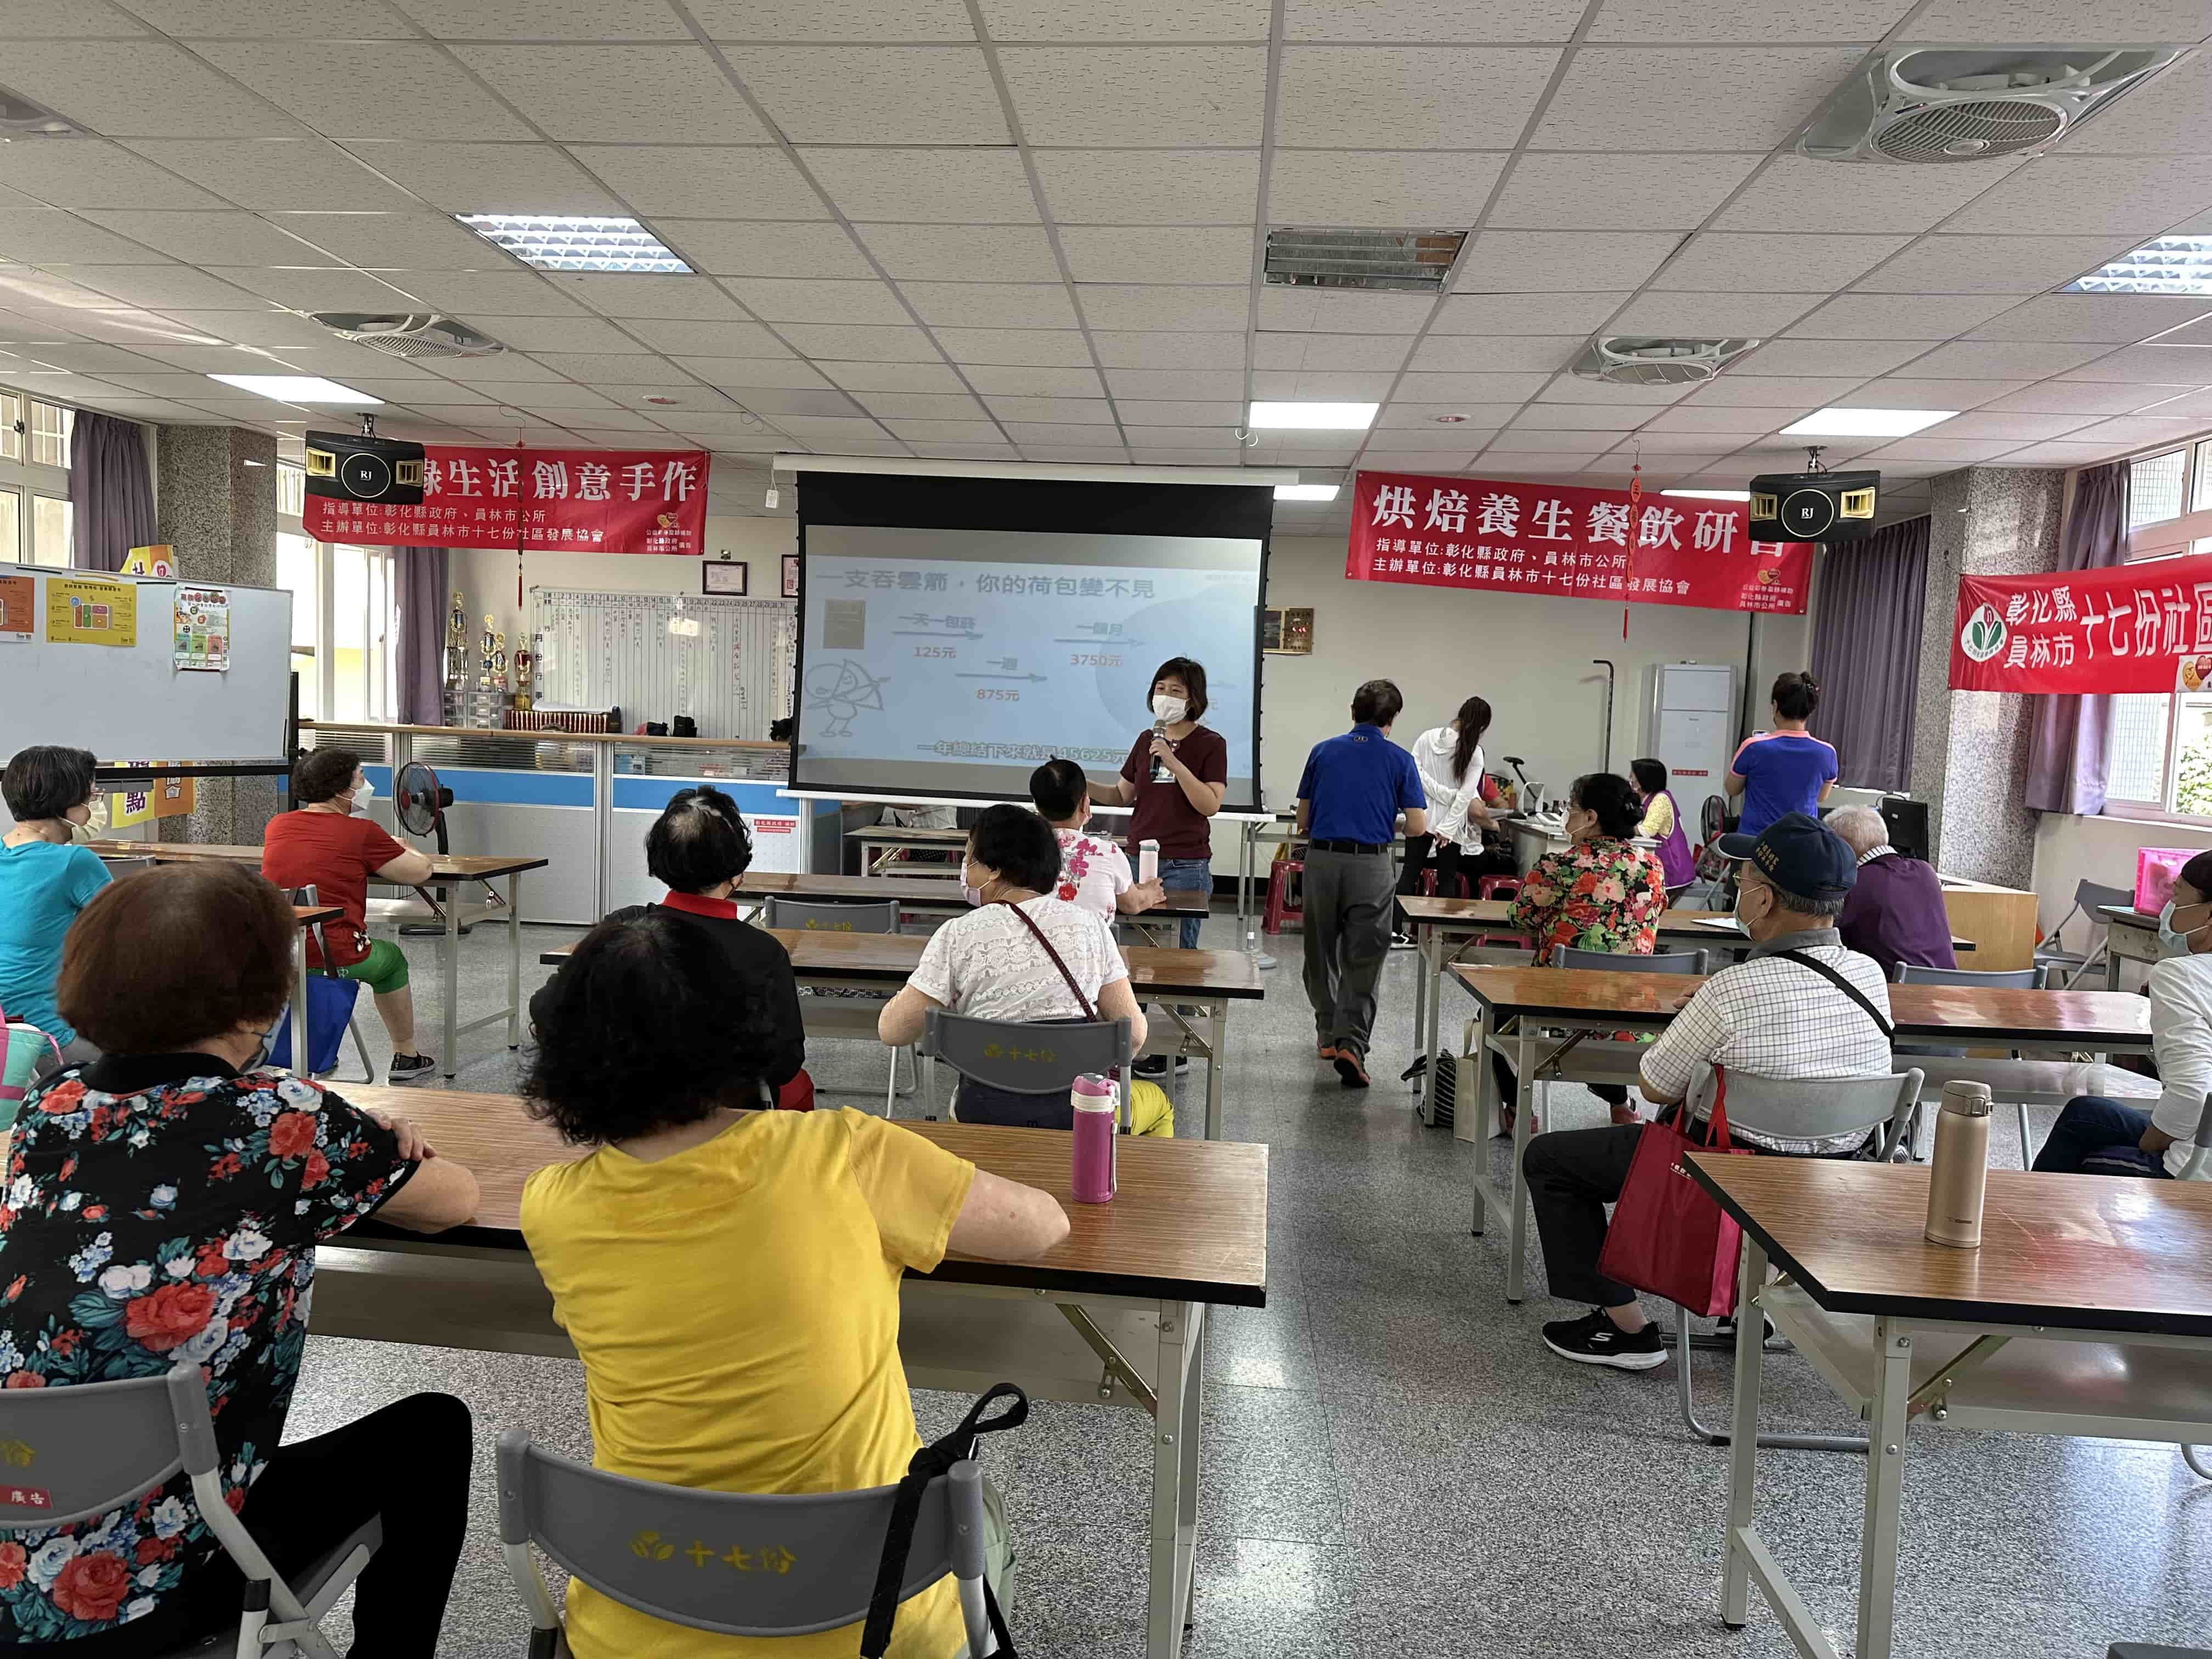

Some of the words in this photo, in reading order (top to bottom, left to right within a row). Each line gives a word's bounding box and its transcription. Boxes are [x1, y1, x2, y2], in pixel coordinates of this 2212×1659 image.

[360, 470, 373, 481] RJ
[1801, 508, 1814, 519] RJ
[2006, 585, 2078, 627] 彰化縣
[913, 646, 957, 659] 125元
[2004, 632, 2075, 669] 員林市
[1071, 653, 1124, 667] 3750元
[978, 689, 1019, 702] 875元
[685, 1540, 799, 1576] 十七份
